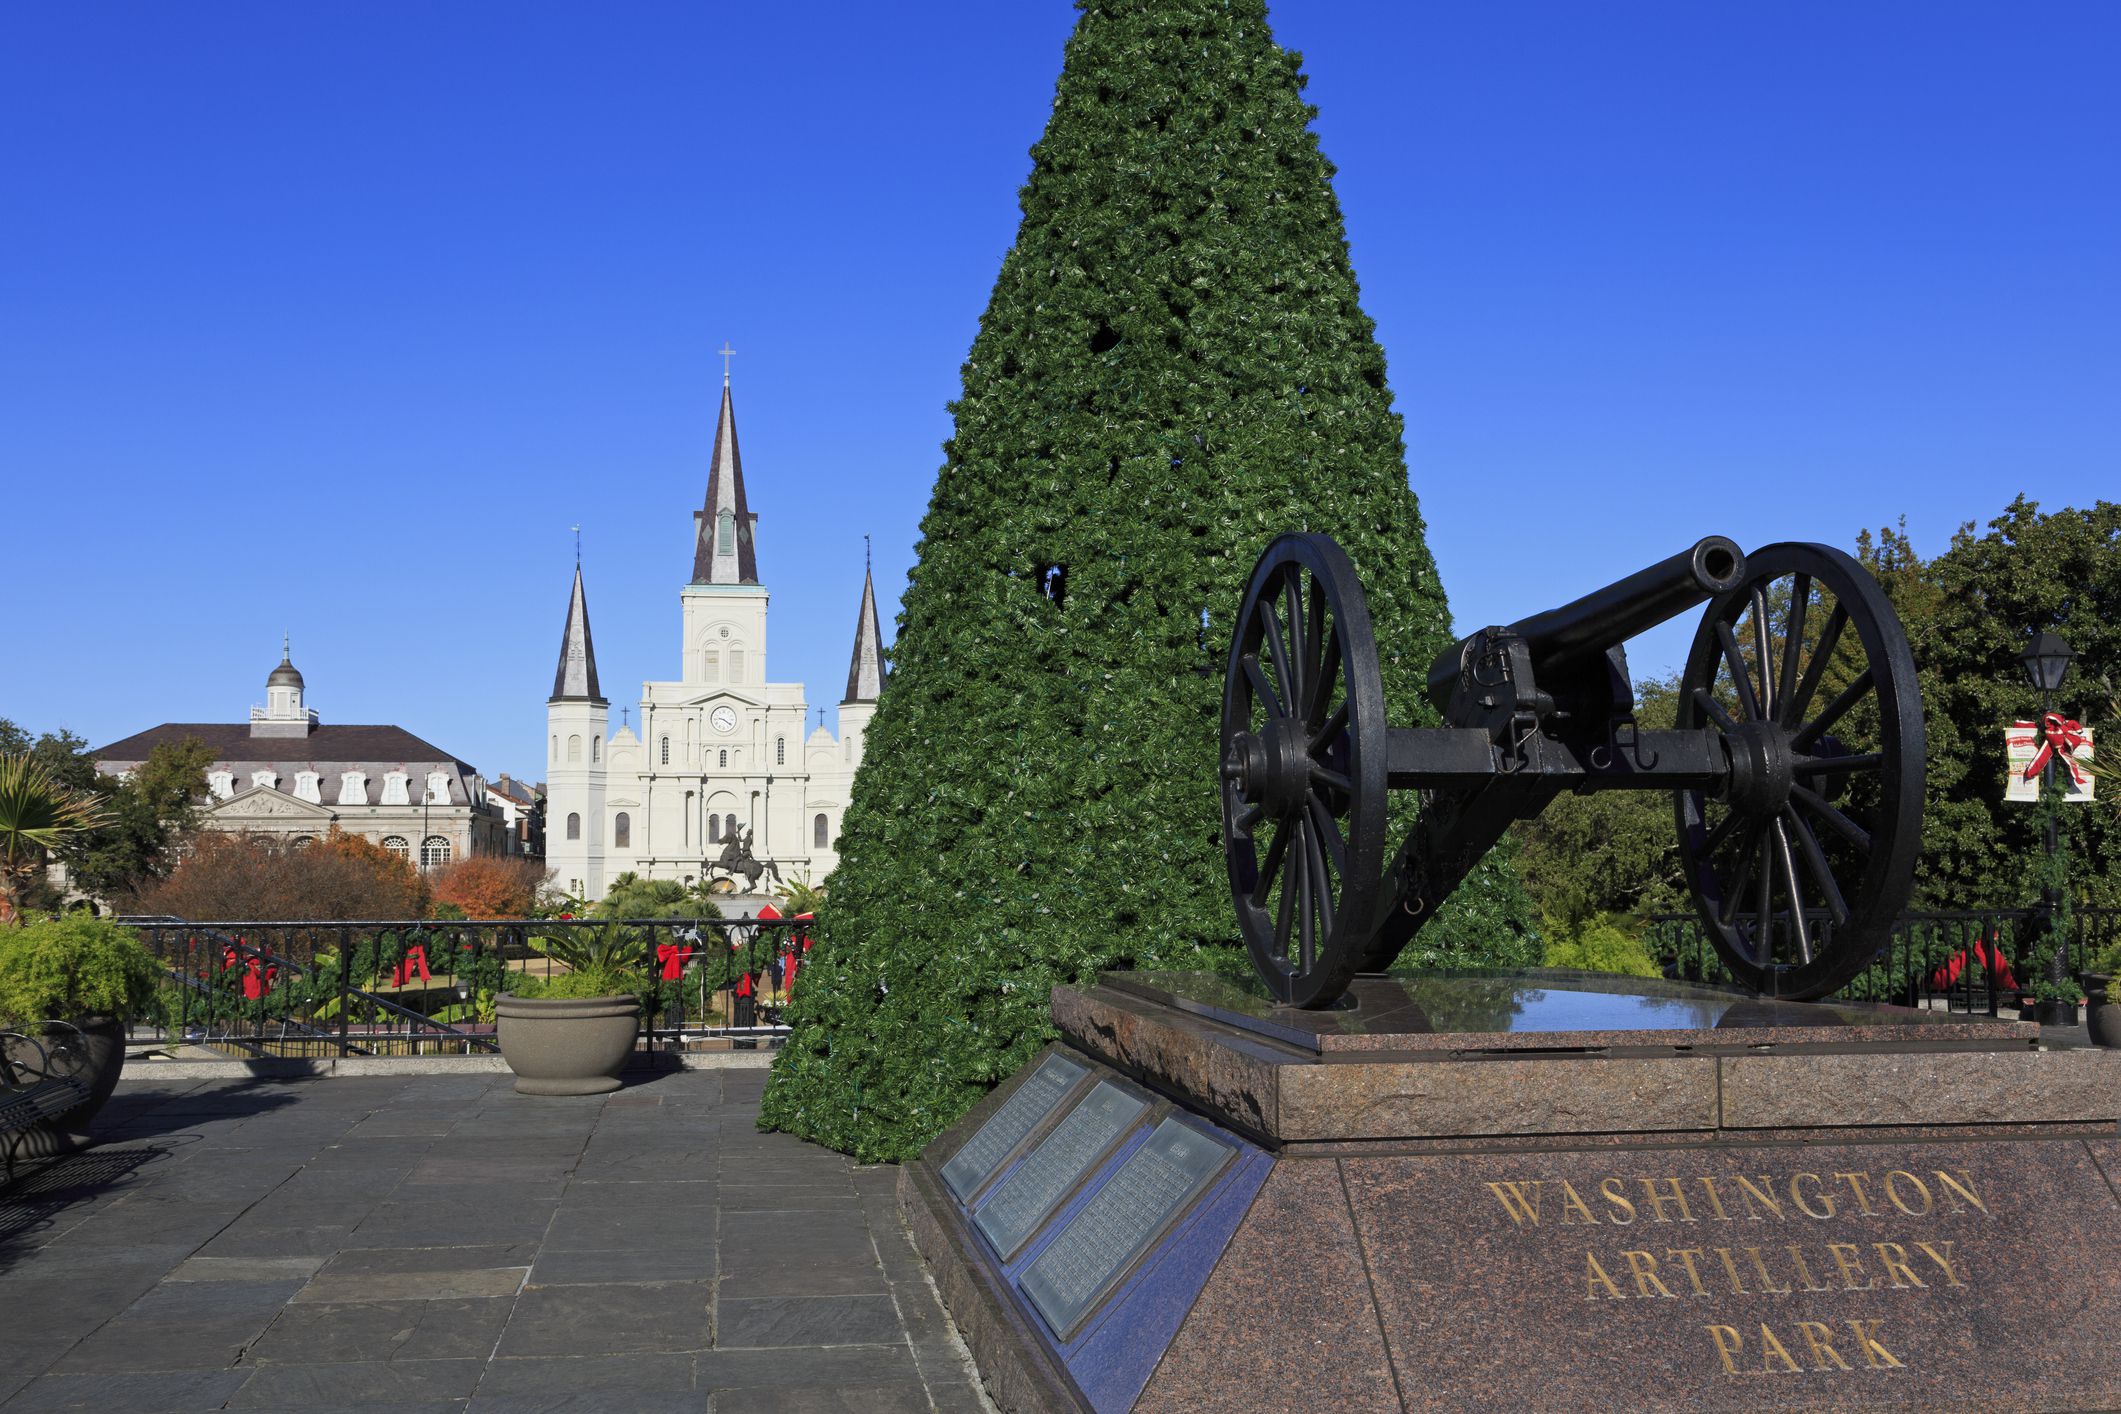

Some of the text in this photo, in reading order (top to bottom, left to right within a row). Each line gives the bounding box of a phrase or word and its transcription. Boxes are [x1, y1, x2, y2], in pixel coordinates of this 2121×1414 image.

[1485, 1170, 1996, 1226] WASHINGTON
[1584, 1242, 1966, 1300] ARTILLERY
[1704, 1320, 1906, 1374] PARK
